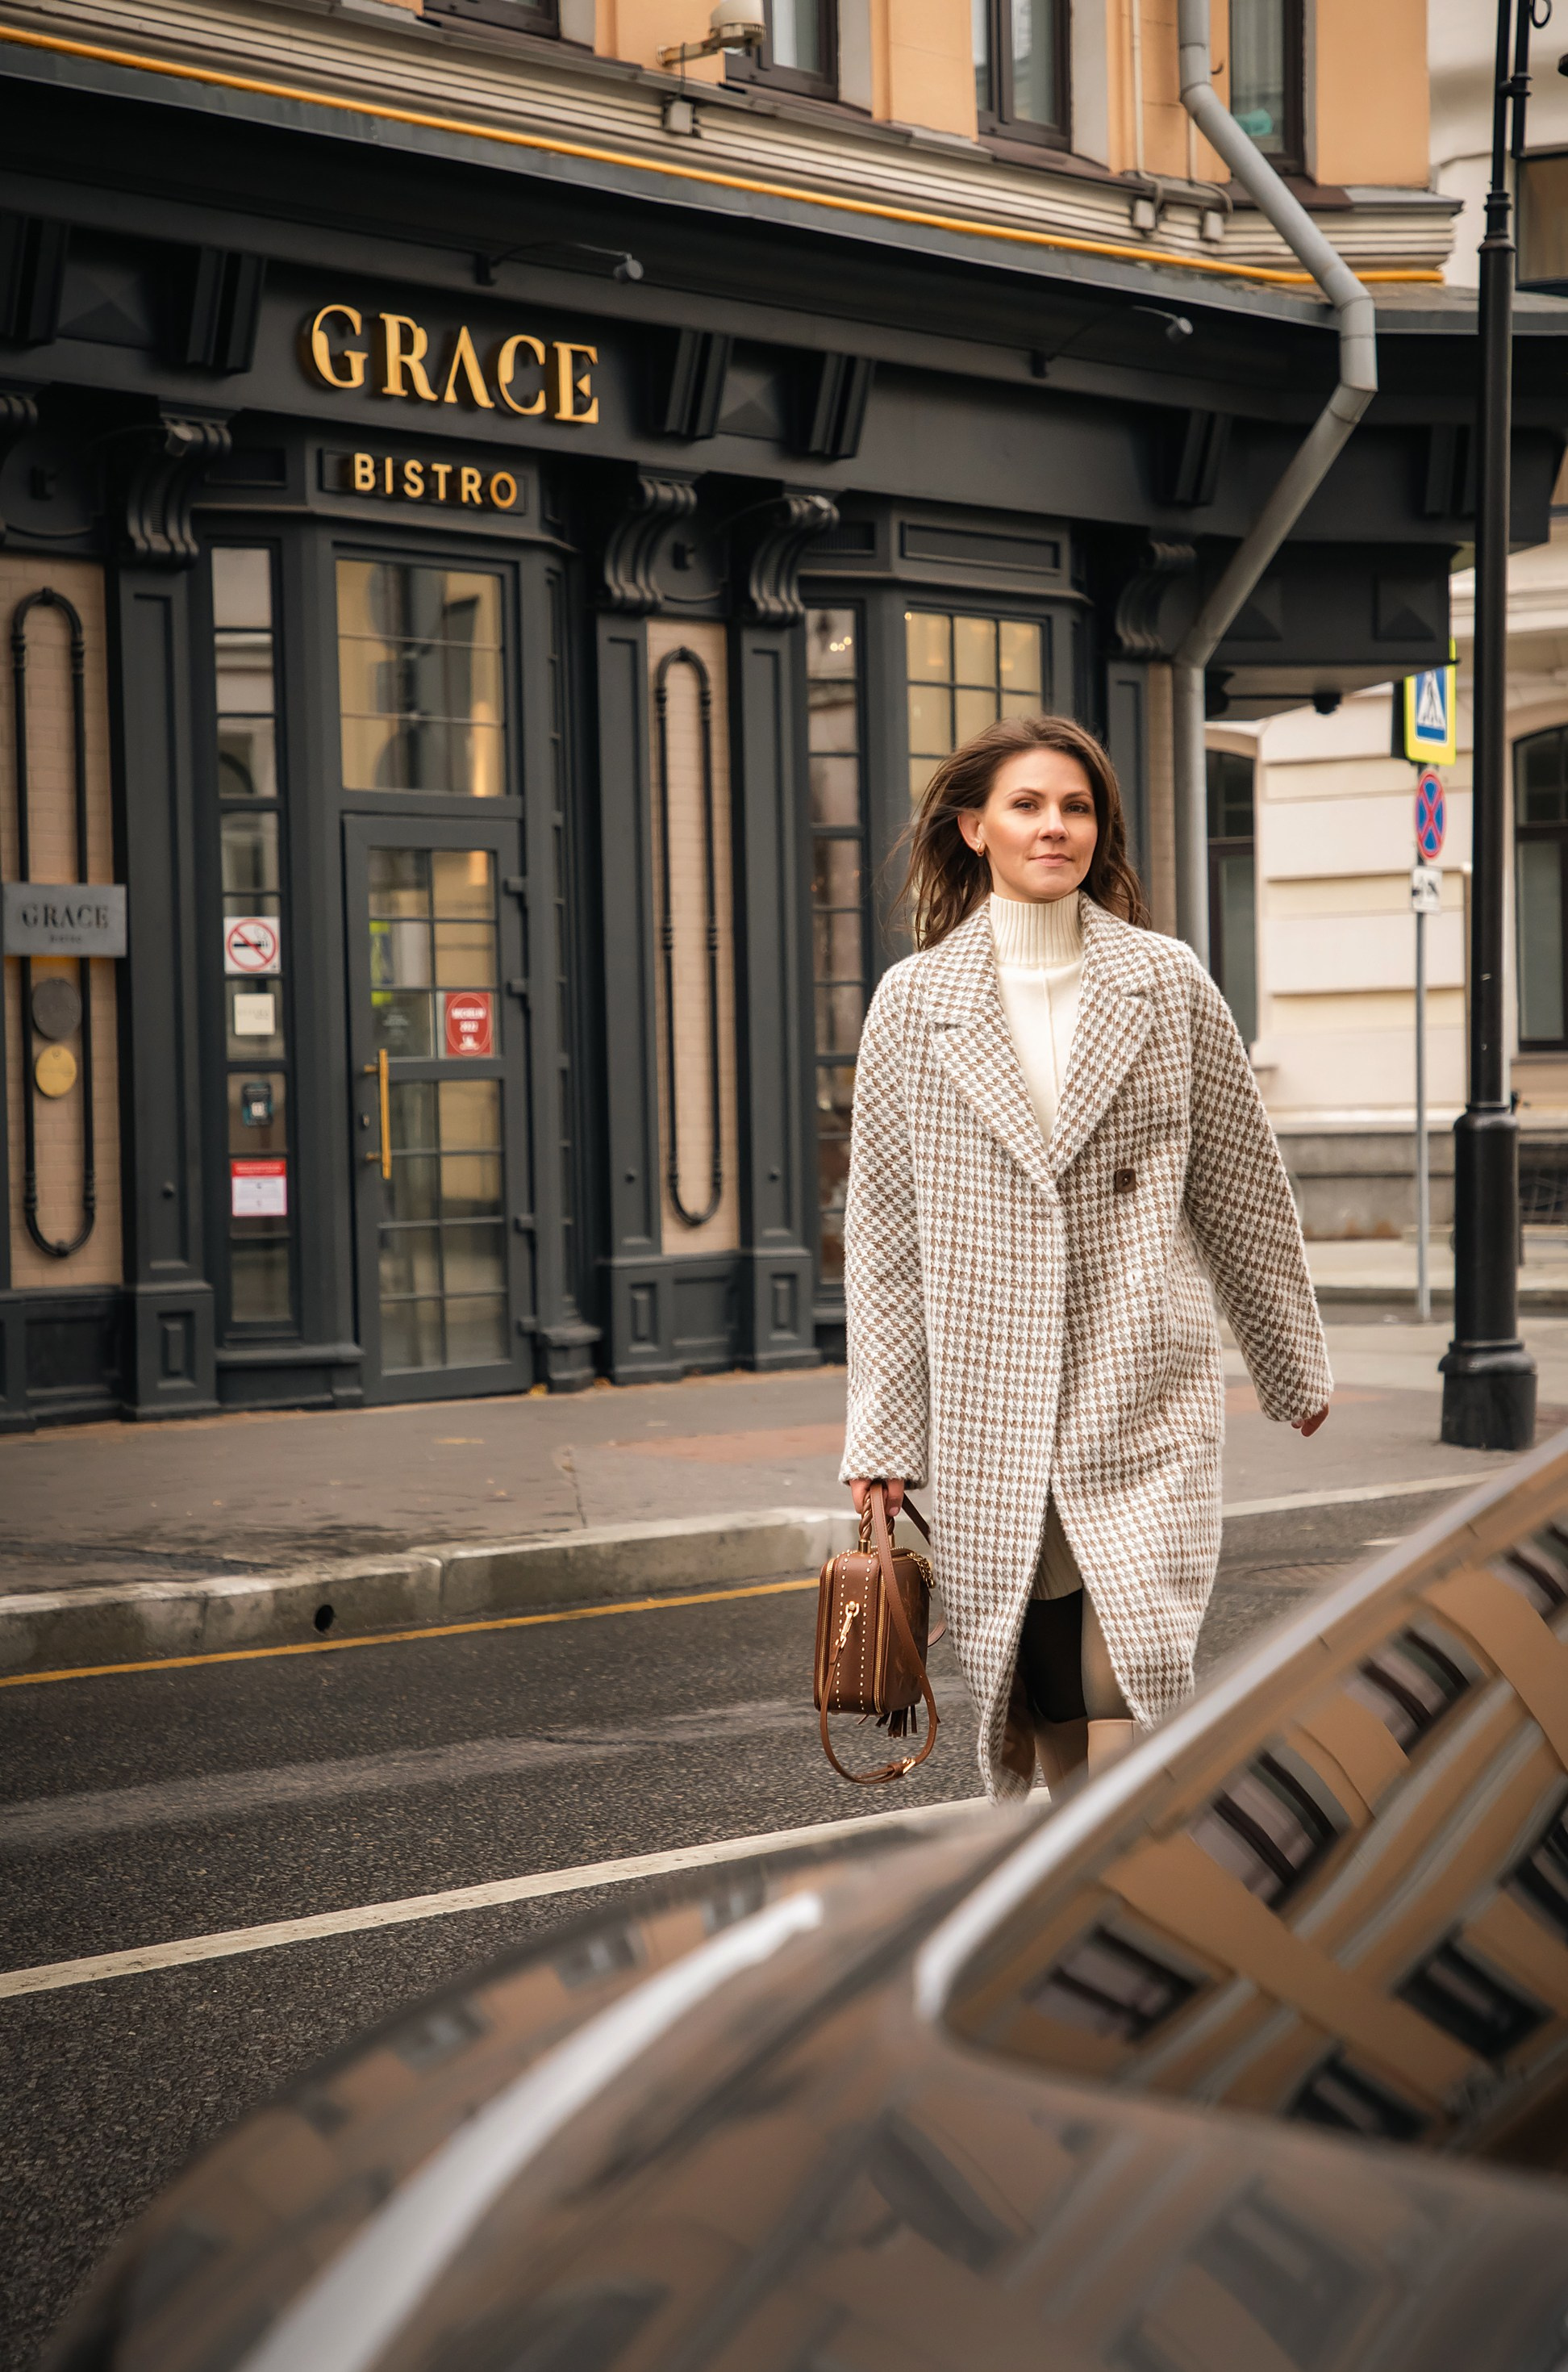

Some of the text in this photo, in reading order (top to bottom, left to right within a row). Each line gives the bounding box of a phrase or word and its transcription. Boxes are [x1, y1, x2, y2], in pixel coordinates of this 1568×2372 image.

[311, 304, 598, 424] GRACE
[354, 453, 517, 508] BISTRO
[22, 903, 109, 929] GRACE
